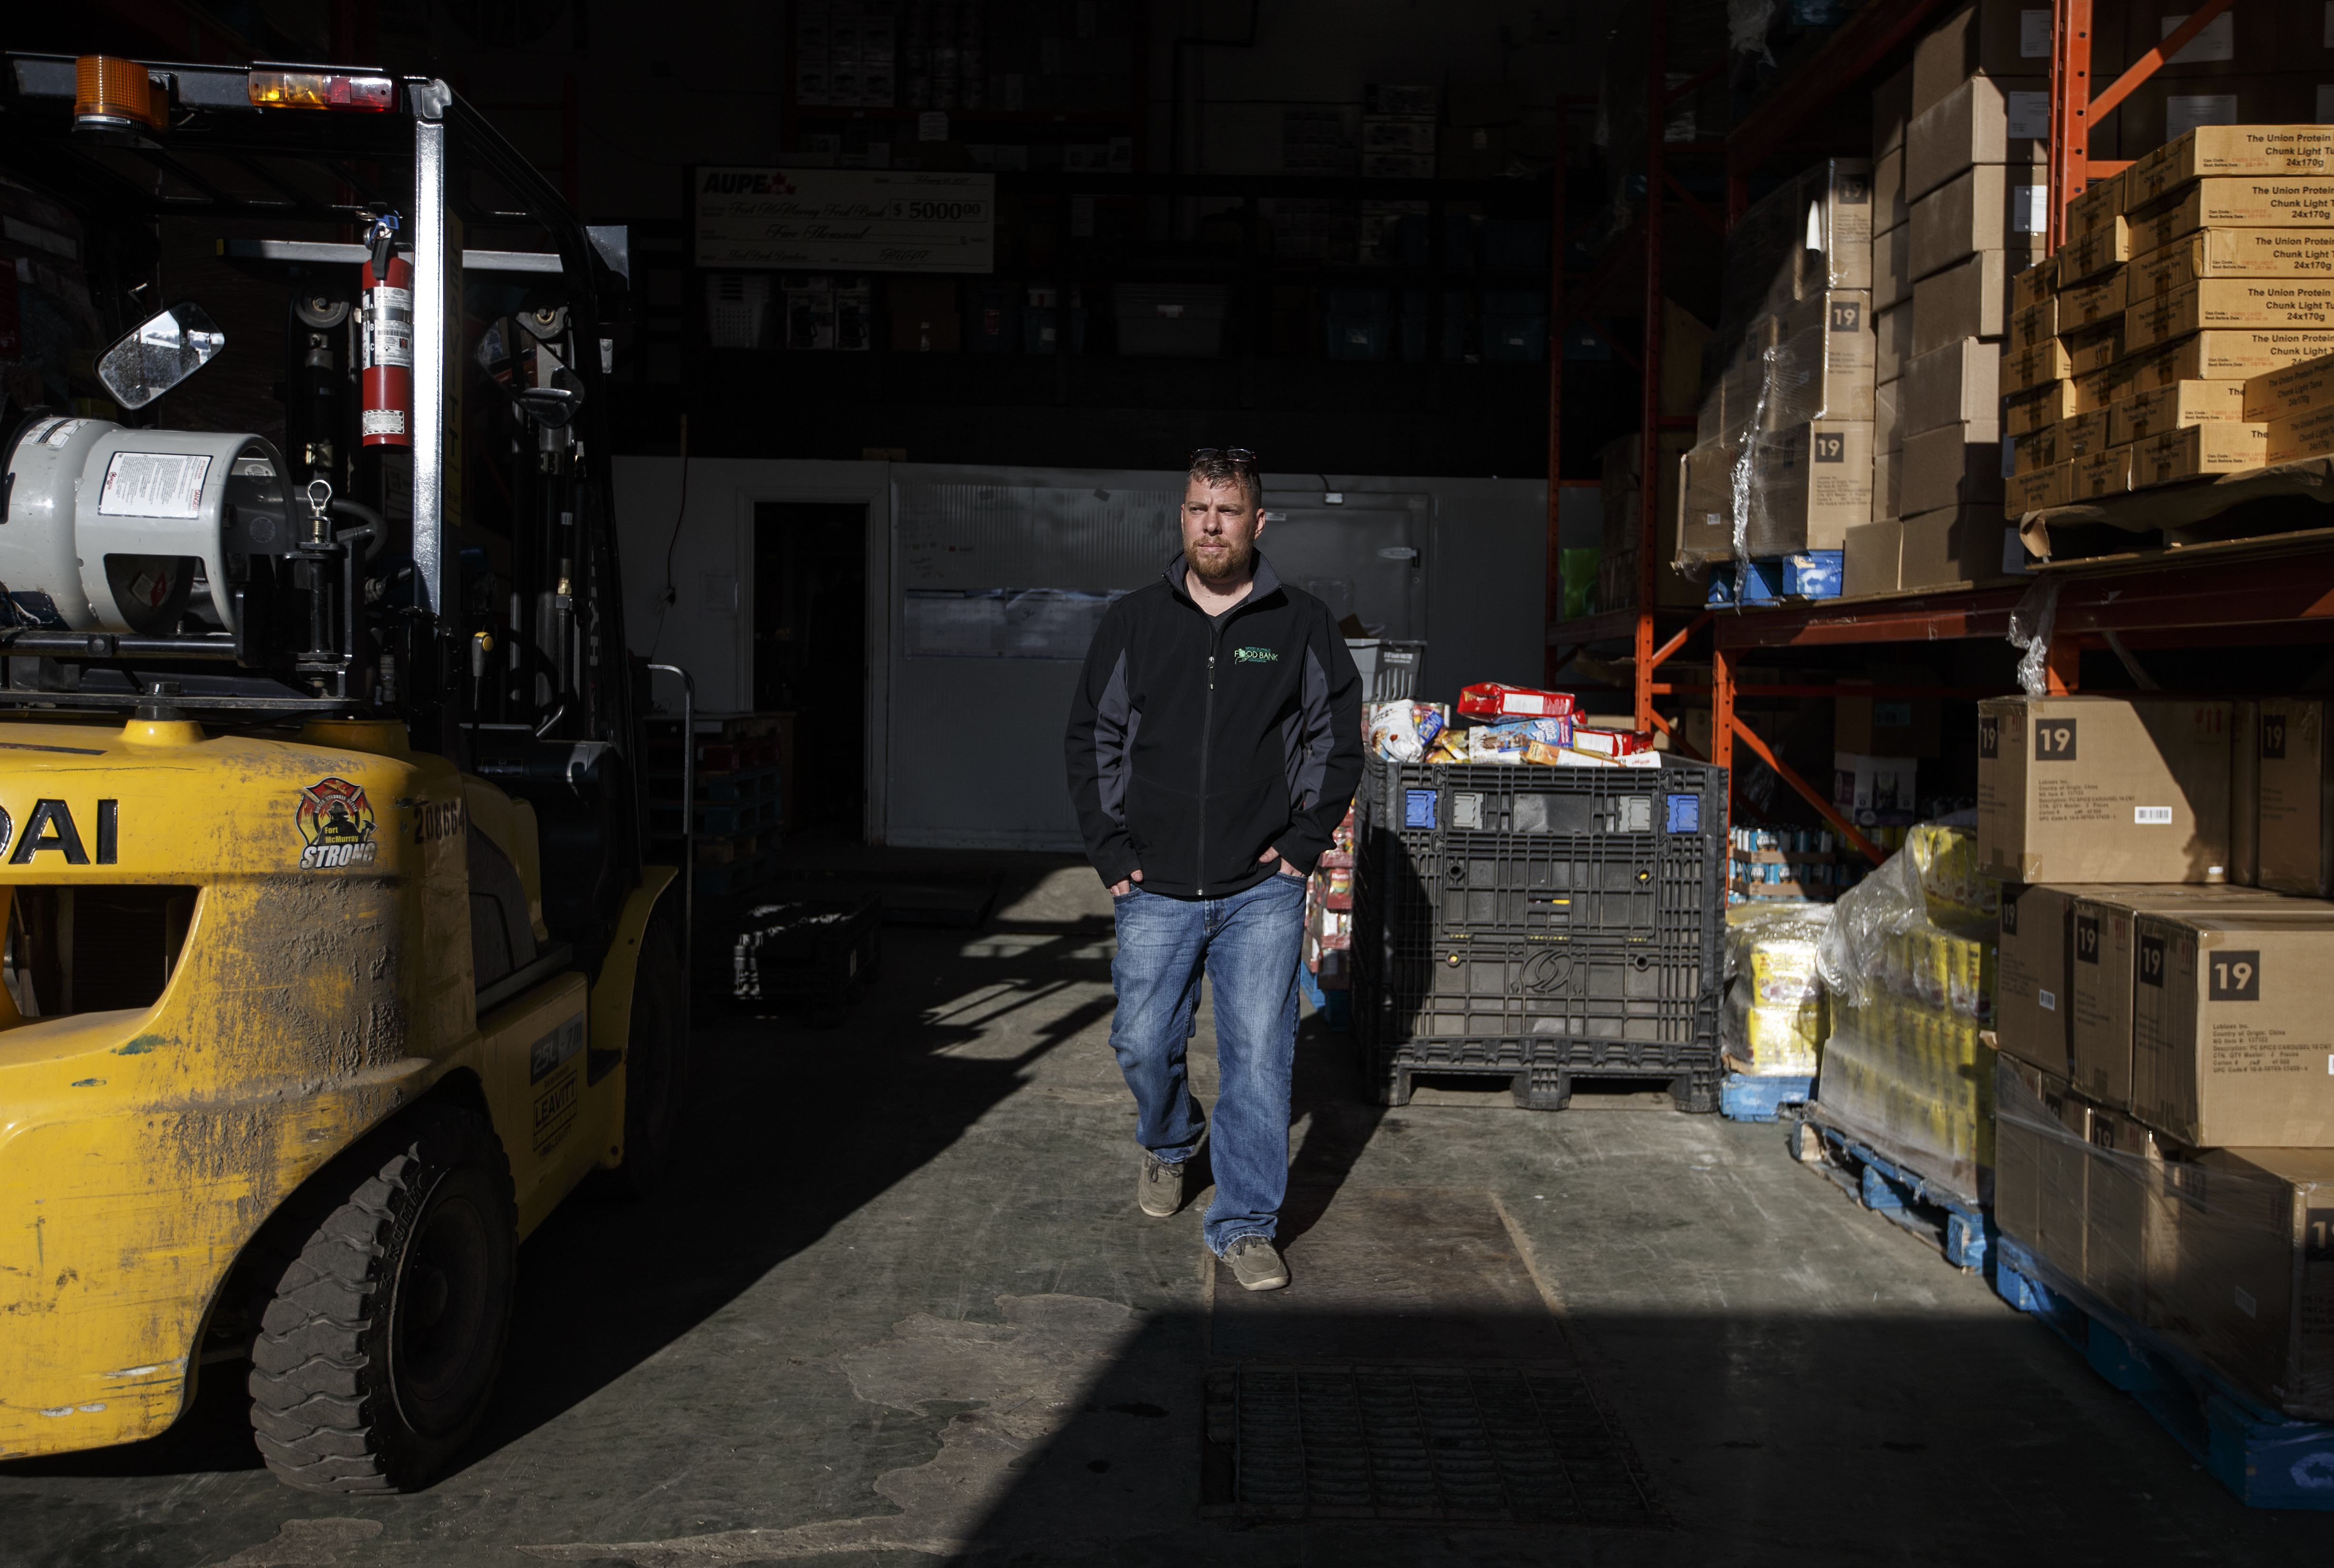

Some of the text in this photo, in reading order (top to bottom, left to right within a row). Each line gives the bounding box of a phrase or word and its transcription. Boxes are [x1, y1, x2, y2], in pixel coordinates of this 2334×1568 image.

[2267, 134, 2294, 142] Union
[2297, 147, 2321, 156] Light
[2286, 158, 2324, 167] 24x170g
[702, 173, 768, 195] AUPE
[1844, 182, 1862, 198] 19
[2273, 186, 2299, 195] Union
[729, 202, 756, 214] Fort
[759, 202, 821, 219] McMurray
[823, 204, 856, 216] Food
[893, 203, 902, 216] $
[2304, 199, 2328, 208] Light
[2292, 211, 2330, 219] 24x170g
[765, 224, 872, 240] Five Thousand
[2305, 251, 2328, 259] Light
[2294, 262, 2331, 270] 24x170g
[2298, 302, 2322, 310] Light
[1834, 309, 1856, 326] 19
[2287, 312, 2324, 321] 24x170g
[370, 323, 374, 331] B
[370, 343, 374, 351] C
[2304, 347, 2327, 356] Light
[2269, 380, 2277, 388] The
[2279, 375, 2293, 384] Union
[2295, 369, 2313, 380] Protein
[2278, 380, 2322, 398] Chunk Light Tuna
[2288, 395, 2310, 406] 24x170g
[2291, 423, 2299, 431] The
[2300, 419, 2314, 428] Union
[2299, 432, 2314, 442] Chunk
[1818, 439, 1840, 457] 19
[198, 460, 207, 479] ATTENTION
[1259, 652, 1278, 662] BANK
[1983, 727, 1995, 749] 19
[2040, 728, 2071, 752] 19
[2266, 725, 2283, 750] 19
[0, 799, 118, 865] AI
[325, 827, 339, 835] Fort
[325, 835, 359, 844] McMurray
[301, 842, 376, 868] STRONG
[2003, 904, 2015, 923] 19
[2079, 927, 2096, 952] 19
[2143, 947, 2160, 975] 19
[2214, 962, 2253, 990] 19
[535, 1077, 576, 1128] LEAVITT
[2096, 1126, 2112, 1148] 19
[387, 1173, 427, 1261] KUMHO
[2311, 1221, 2334, 1249] 1
